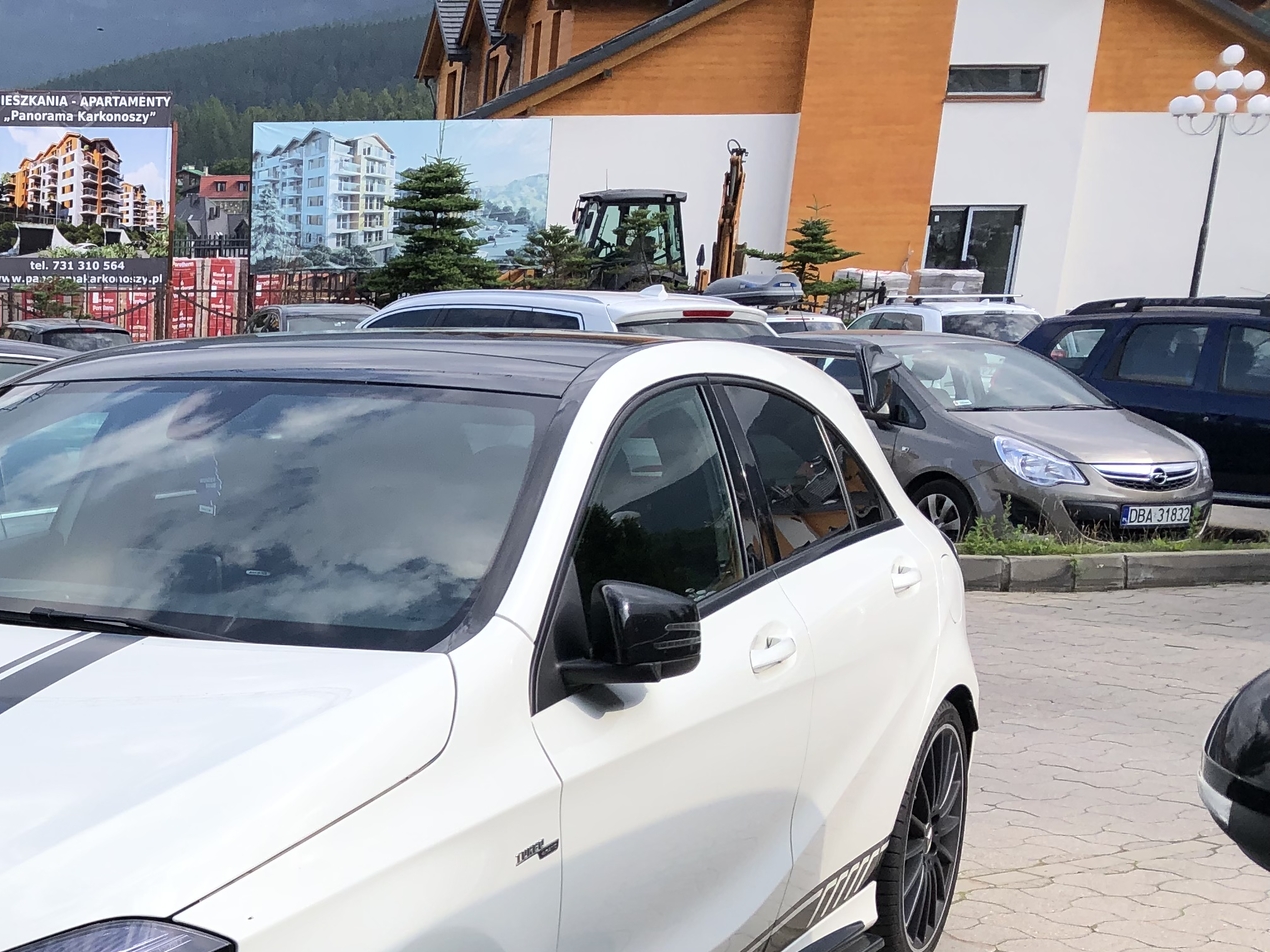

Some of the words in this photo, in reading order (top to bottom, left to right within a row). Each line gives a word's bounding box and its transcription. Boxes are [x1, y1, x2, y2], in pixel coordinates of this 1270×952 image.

[80, 96, 171, 107] APARTAMENTY
[4, 110, 74, 122] „Panorama
[78, 111, 157, 124] Karkonoszy”
[30, 261, 49, 270] tel.
[53, 261, 74, 270] 731
[77, 261, 100, 270] 310
[103, 261, 125, 270] 564
[1129, 508, 1153, 523] DBA
[1156, 507, 1190, 523] 31832
